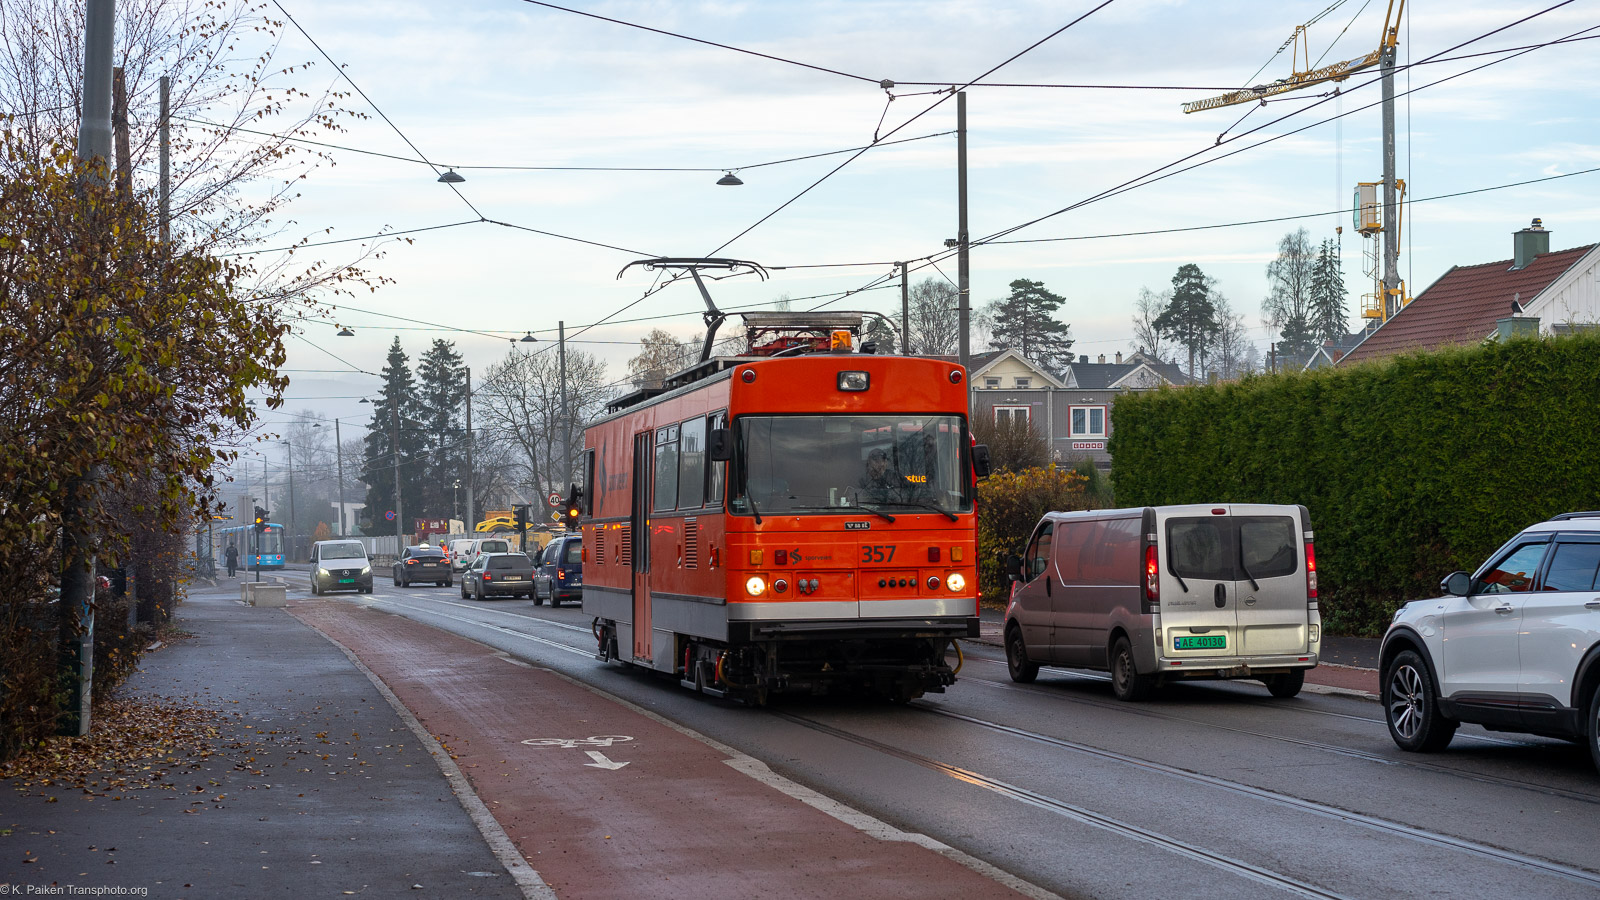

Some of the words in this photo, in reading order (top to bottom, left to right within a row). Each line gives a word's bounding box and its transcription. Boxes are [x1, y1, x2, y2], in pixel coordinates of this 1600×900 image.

[551, 496, 560, 504] 40
[861, 545, 896, 563] 357
[1182, 638, 1193, 647] AE
[1197, 637, 1223, 647] 40130
